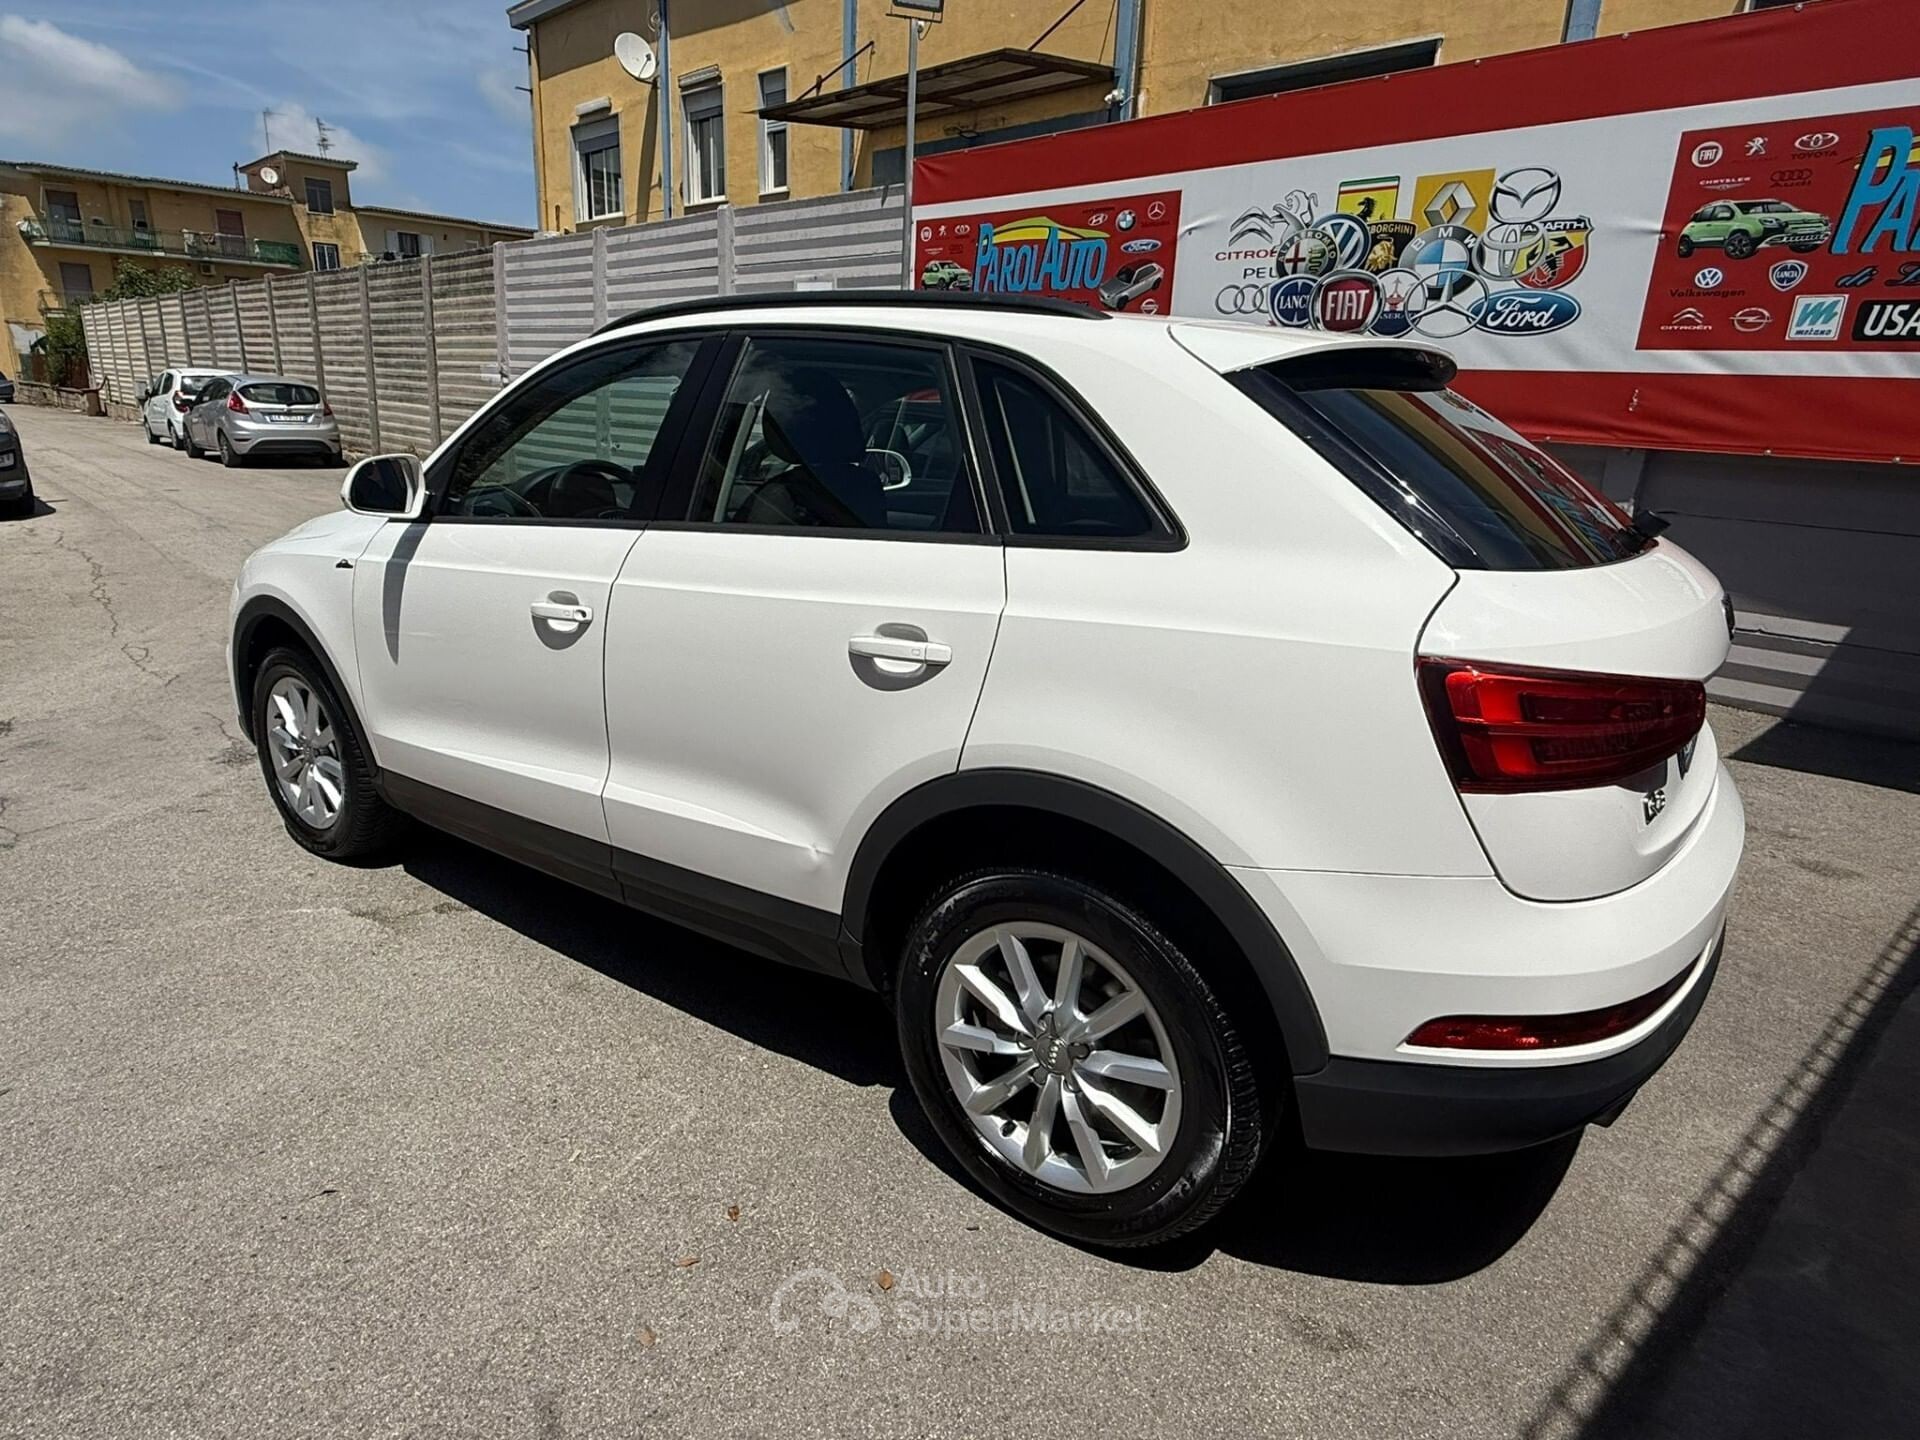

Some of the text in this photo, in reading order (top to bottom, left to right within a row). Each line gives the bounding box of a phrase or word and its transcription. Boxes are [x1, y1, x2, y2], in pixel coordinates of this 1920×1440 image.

[1792, 151, 1838, 160] TOYOTA
[1831, 126, 1920, 254] PA
[1369, 223, 1414, 235] BORGHINI
[1523, 222, 1585, 232] AARTH
[1670, 289, 1746, 298] Volkswagen
[1279, 294, 1310, 310] LANCI
[1325, 289, 1370, 321] FIAT
[1486, 296, 1558, 328] Ford
